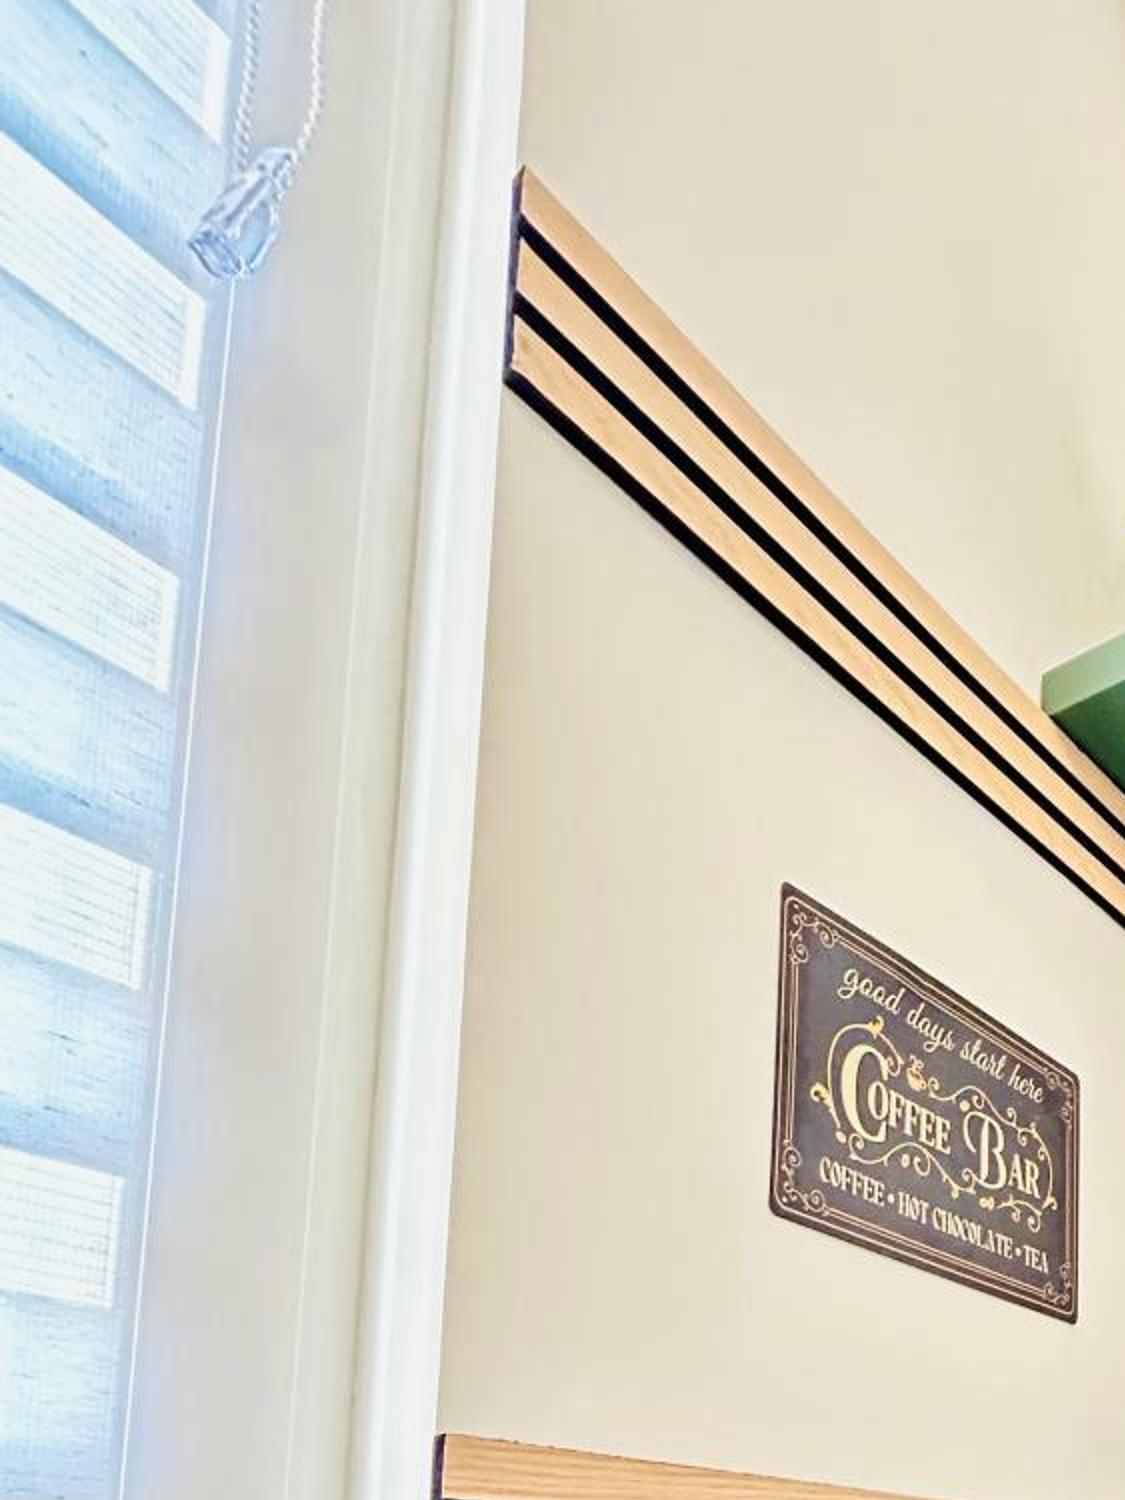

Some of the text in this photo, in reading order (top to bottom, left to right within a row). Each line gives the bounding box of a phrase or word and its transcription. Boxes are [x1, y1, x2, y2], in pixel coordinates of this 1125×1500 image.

[837, 968, 1044, 1103] good days start here
[819, 1156, 1049, 1274] COFFEE HOT CHOCOLATE TEA
